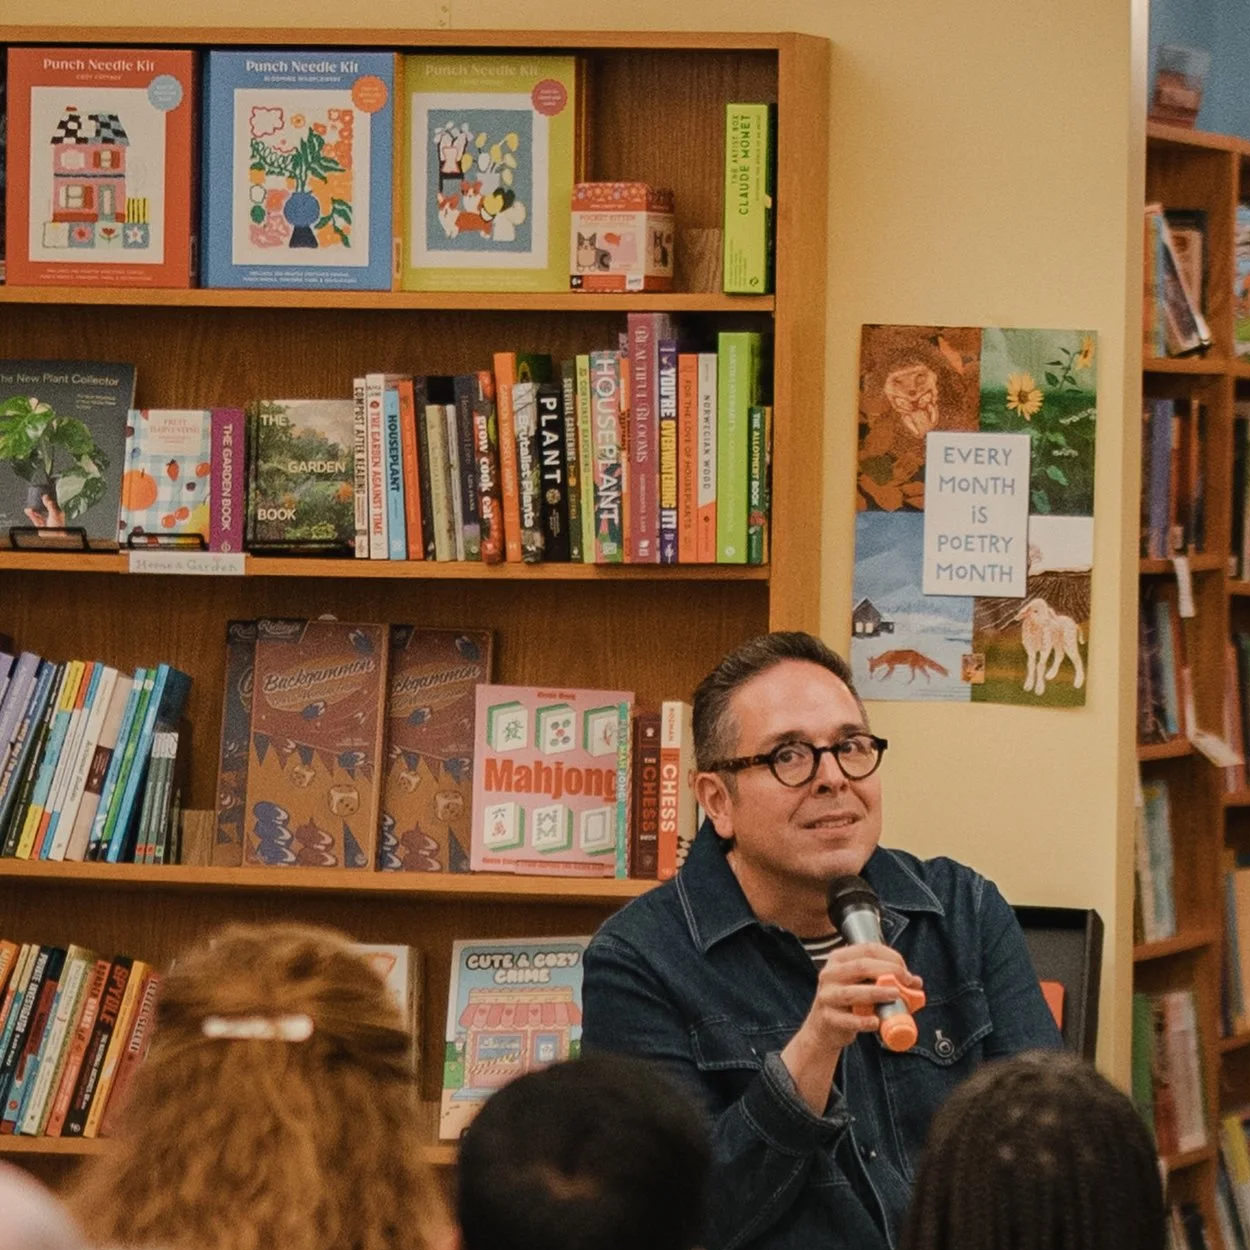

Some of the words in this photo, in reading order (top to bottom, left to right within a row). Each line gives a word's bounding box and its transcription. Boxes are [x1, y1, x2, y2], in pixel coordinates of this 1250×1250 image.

[43, 58, 84, 71] Punch
[88, 59, 133, 71] Needle
[137, 59, 156, 72] Kit
[246, 60, 287, 73] Punch
[291, 60, 336, 73] Needle
[340, 61, 359, 73] Kit
[425, 64, 468, 76] Punch
[472, 65, 516, 76] Needle
[520, 66, 539, 77] Kit
[740, 115, 751, 159] MONET
[738, 165, 750, 215] CLAUDE
[635, 325, 649, 400] BEAUTIFUL
[16, 373, 40, 384] New
[43, 373, 68, 384] Plant
[71, 374, 120, 387] Collector
[660, 369, 676, 417] YOU'RE
[683, 380, 692, 402] FOR
[354, 386, 365, 425] COMPOST
[563, 378, 575, 415] SURVIVAL
[683, 405, 692, 418] THE
[222, 424, 233, 447] THE
[260, 413, 287, 427] THE
[370, 412, 380, 430] THE
[476, 415, 489, 453] grow
[637, 402, 651, 463] BLOOMS
[683, 421, 692, 444] LOVE
[702, 394, 711, 455] NORWEGIAN
[752, 413, 761, 429] THE
[354, 428, 365, 454] AFTER
[371, 431, 381, 469] GARDEN
[388, 414, 400, 492] HOUSEPLANT
[518, 414, 532, 478] Brutalist
[540, 397, 560, 484] PLANT
[595, 358, 619, 525] HOUSEPLANT
[683, 446, 692, 458] OF
[752, 431, 762, 479] ALLOTMENT
[943, 446, 1013, 467] EVERY
[222, 449, 233, 494] GARDEN
[287, 461, 346, 474] GARDEN
[355, 457, 366, 495] READING
[479, 457, 493, 492] cook
[661, 420, 676, 508] OVERWATERING
[702, 459, 711, 490] WOOD
[372, 471, 382, 509] AGAINST
[752, 481, 762, 506] BOOK
[939, 475, 1015, 497] MONTH
[221, 496, 232, 531] BOOK
[257, 508, 297, 521] BOOK
[482, 496, 494, 519] eat
[521, 481, 535, 528] Plants
[661, 510, 677, 529] IT!
[373, 511, 383, 536] TIME
[938, 534, 1013, 555] POETRY
[935, 563, 1013, 584] MONTH
[262, 656, 376, 695] Backgammon
[392, 664, 482, 696] ckgammon
[484, 757, 617, 804] Mahjong
[641, 764, 656, 833] CHESS
[661, 763, 677, 833] CHESS
[467, 953, 514, 969] CUTE
[517, 954, 530, 968] &
[533, 952, 580, 969] COZY
[494, 969, 551, 985] CRIME
